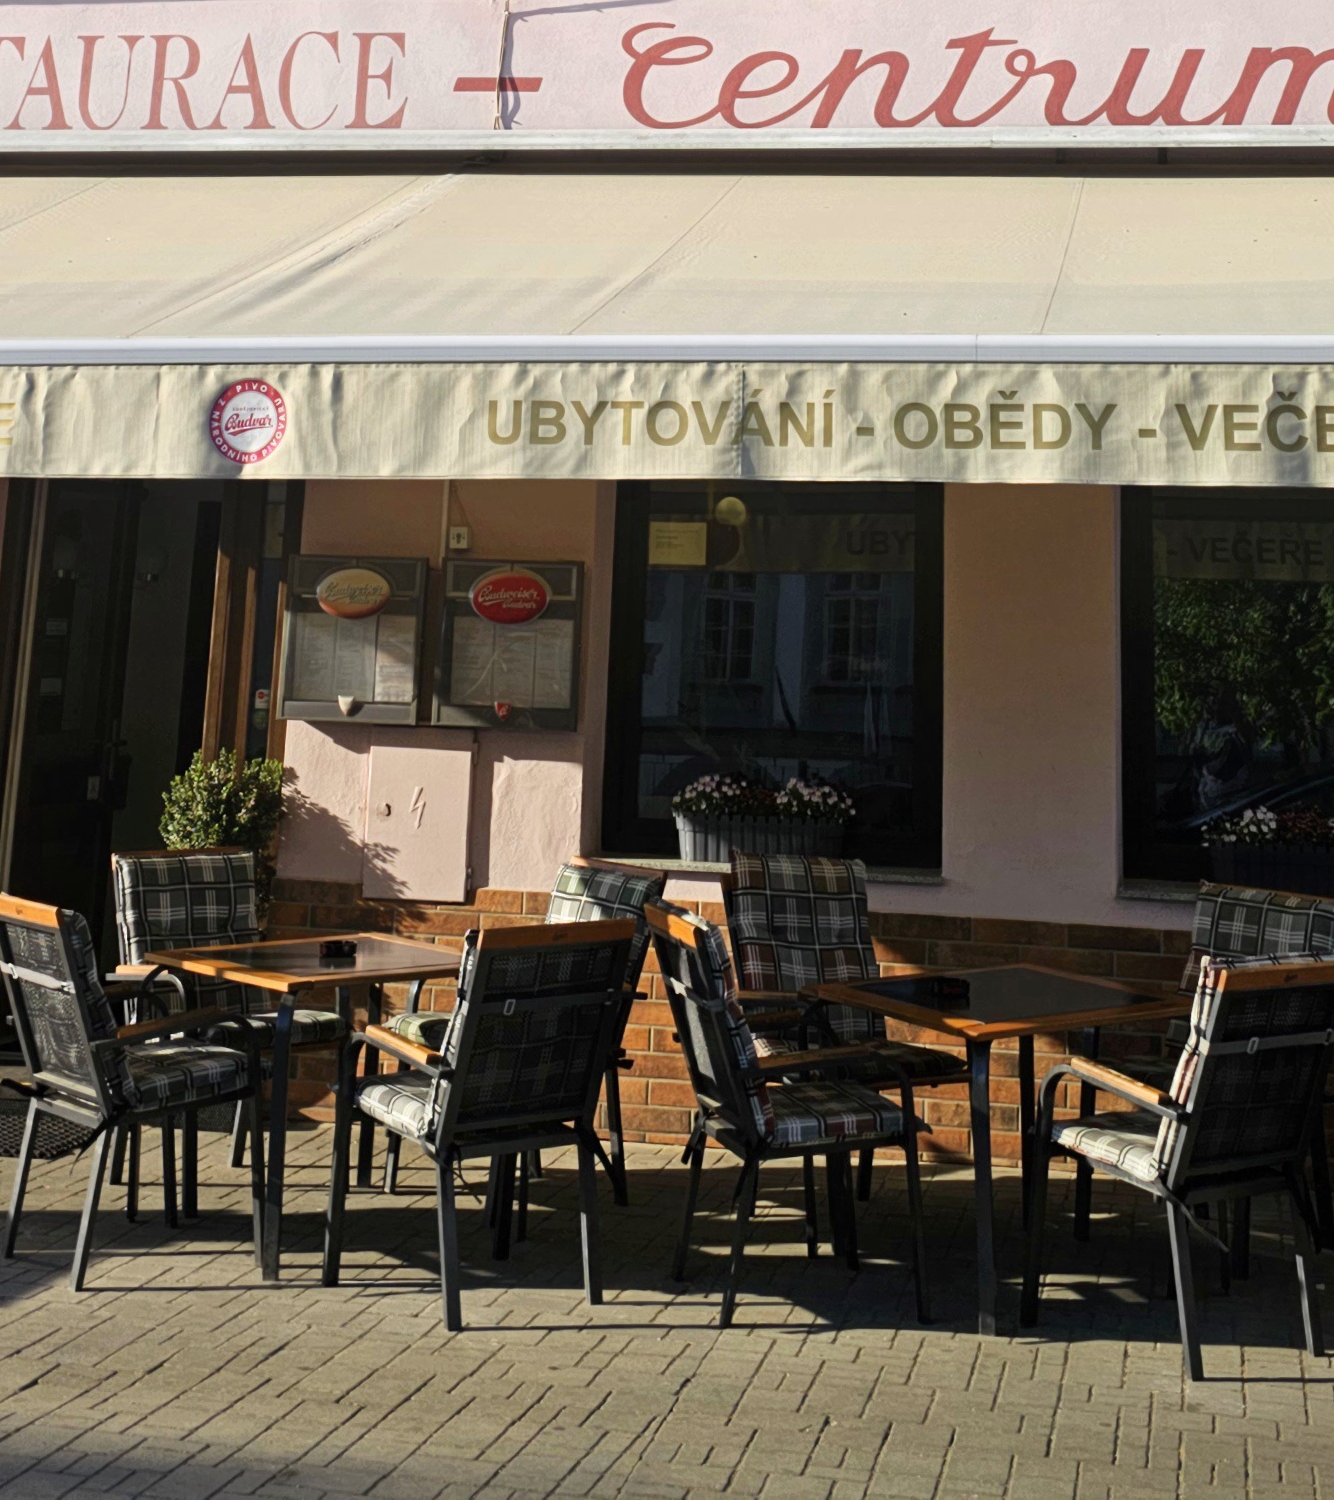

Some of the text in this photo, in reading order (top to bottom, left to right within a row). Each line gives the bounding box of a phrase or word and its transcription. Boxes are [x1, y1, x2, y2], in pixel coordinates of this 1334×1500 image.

[224, 412, 273, 433] Budvar
[486, 388, 837, 448] UBYTOVÁNÍ
[893, 390, 1117, 450] OBĚDY
[478, 584, 541, 605] Budweiser
